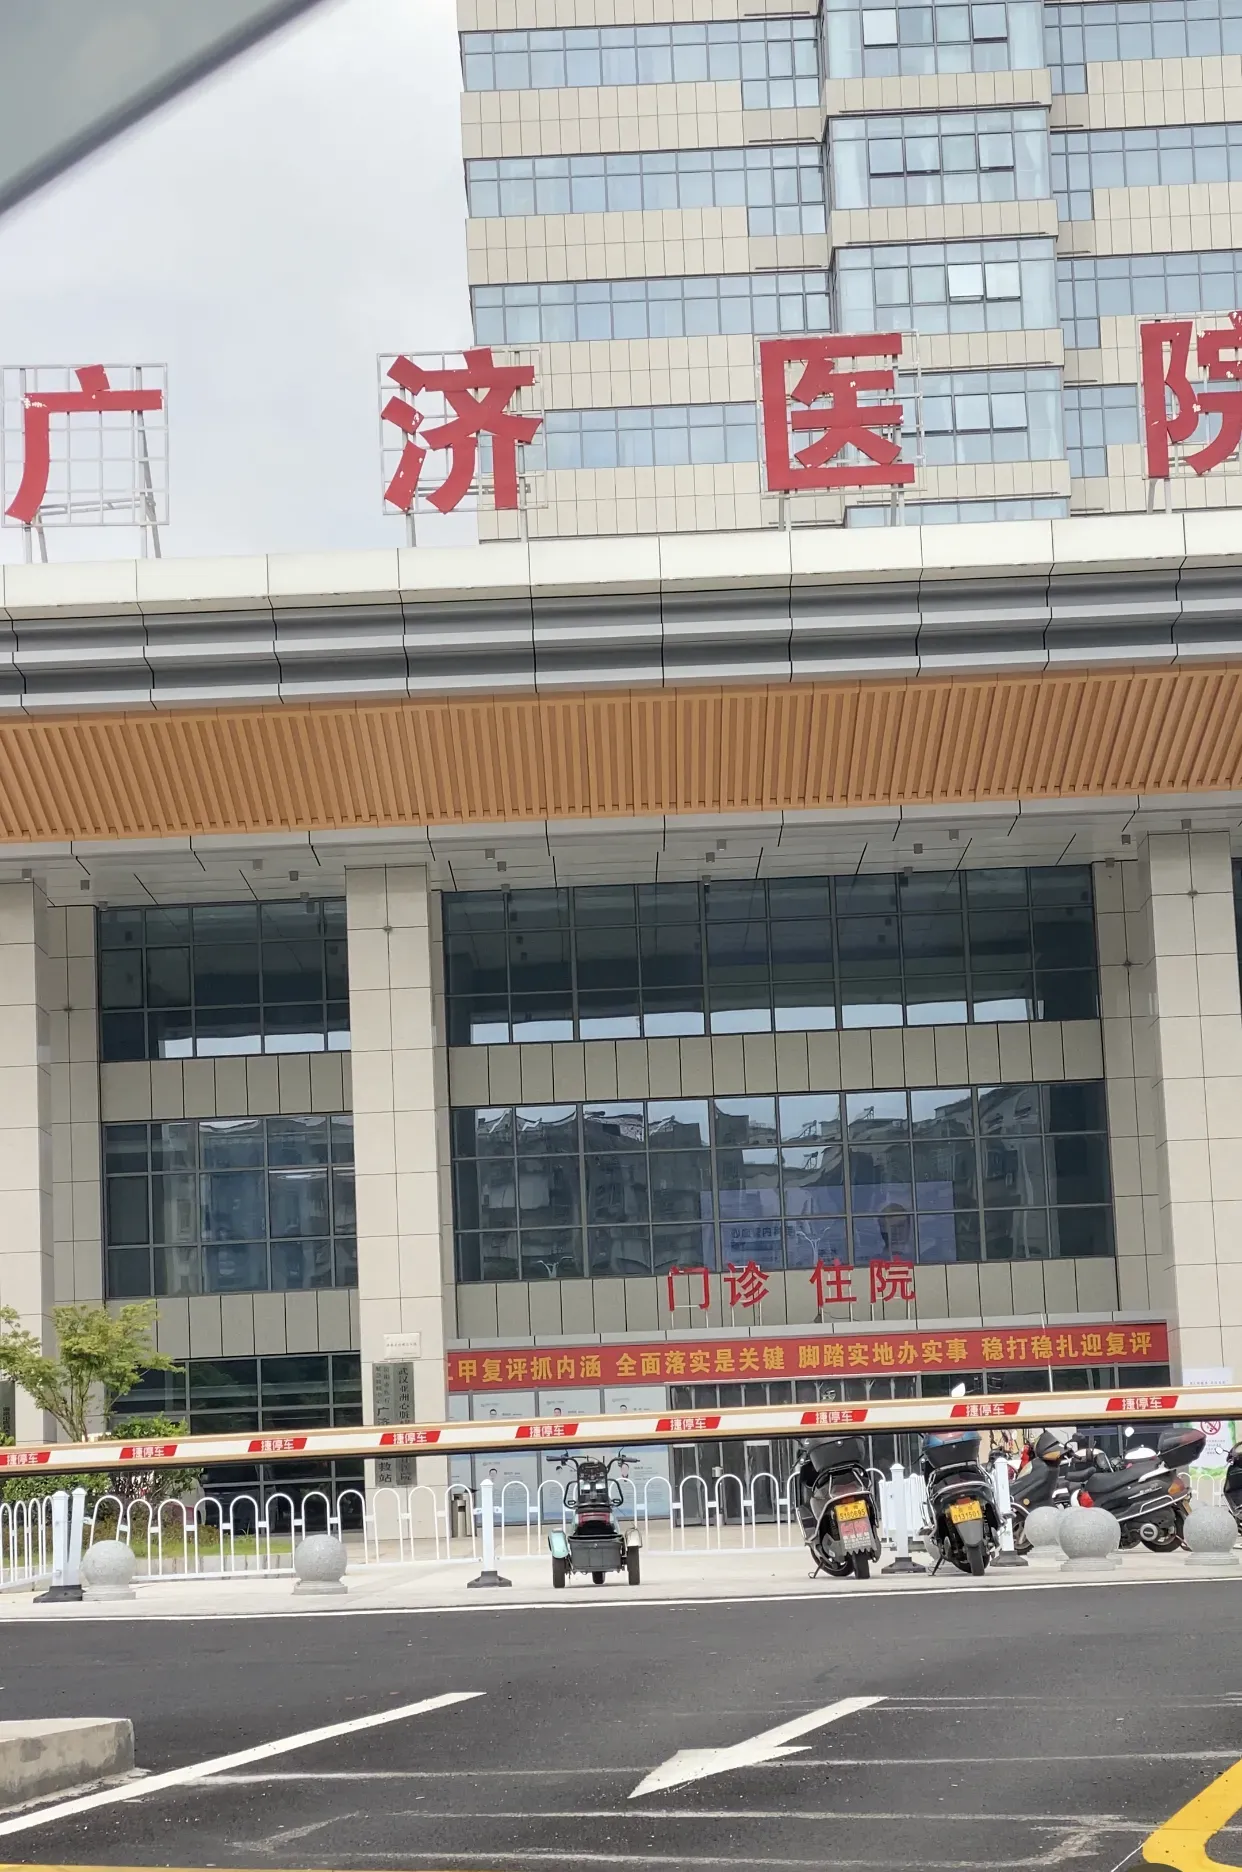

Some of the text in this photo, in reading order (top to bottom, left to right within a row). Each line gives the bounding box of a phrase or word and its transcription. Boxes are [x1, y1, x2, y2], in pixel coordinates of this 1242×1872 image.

[667, 1255, 917, 1312] 门诊 住院
[448, 1331, 1152, 1384] 甲复评抓内涵 全面落实是关键 脚踏实地办实事 稳打稳扎迎复评
[966, 1403, 1005, 1417] 捷停车
[1122, 1396, 1163, 1410] 捷停车
[670, 1417, 706, 1431] 捷停车
[815, 1410, 853, 1424] 捷停车
[529, 1424, 564, 1438] 捷停车
[261, 1439, 294, 1451] 捷停车
[393, 1432, 427, 1445] 捷停车
[7, 1453, 38, 1465] 捷停车
[132, 1446, 165, 1459] 捷停车
